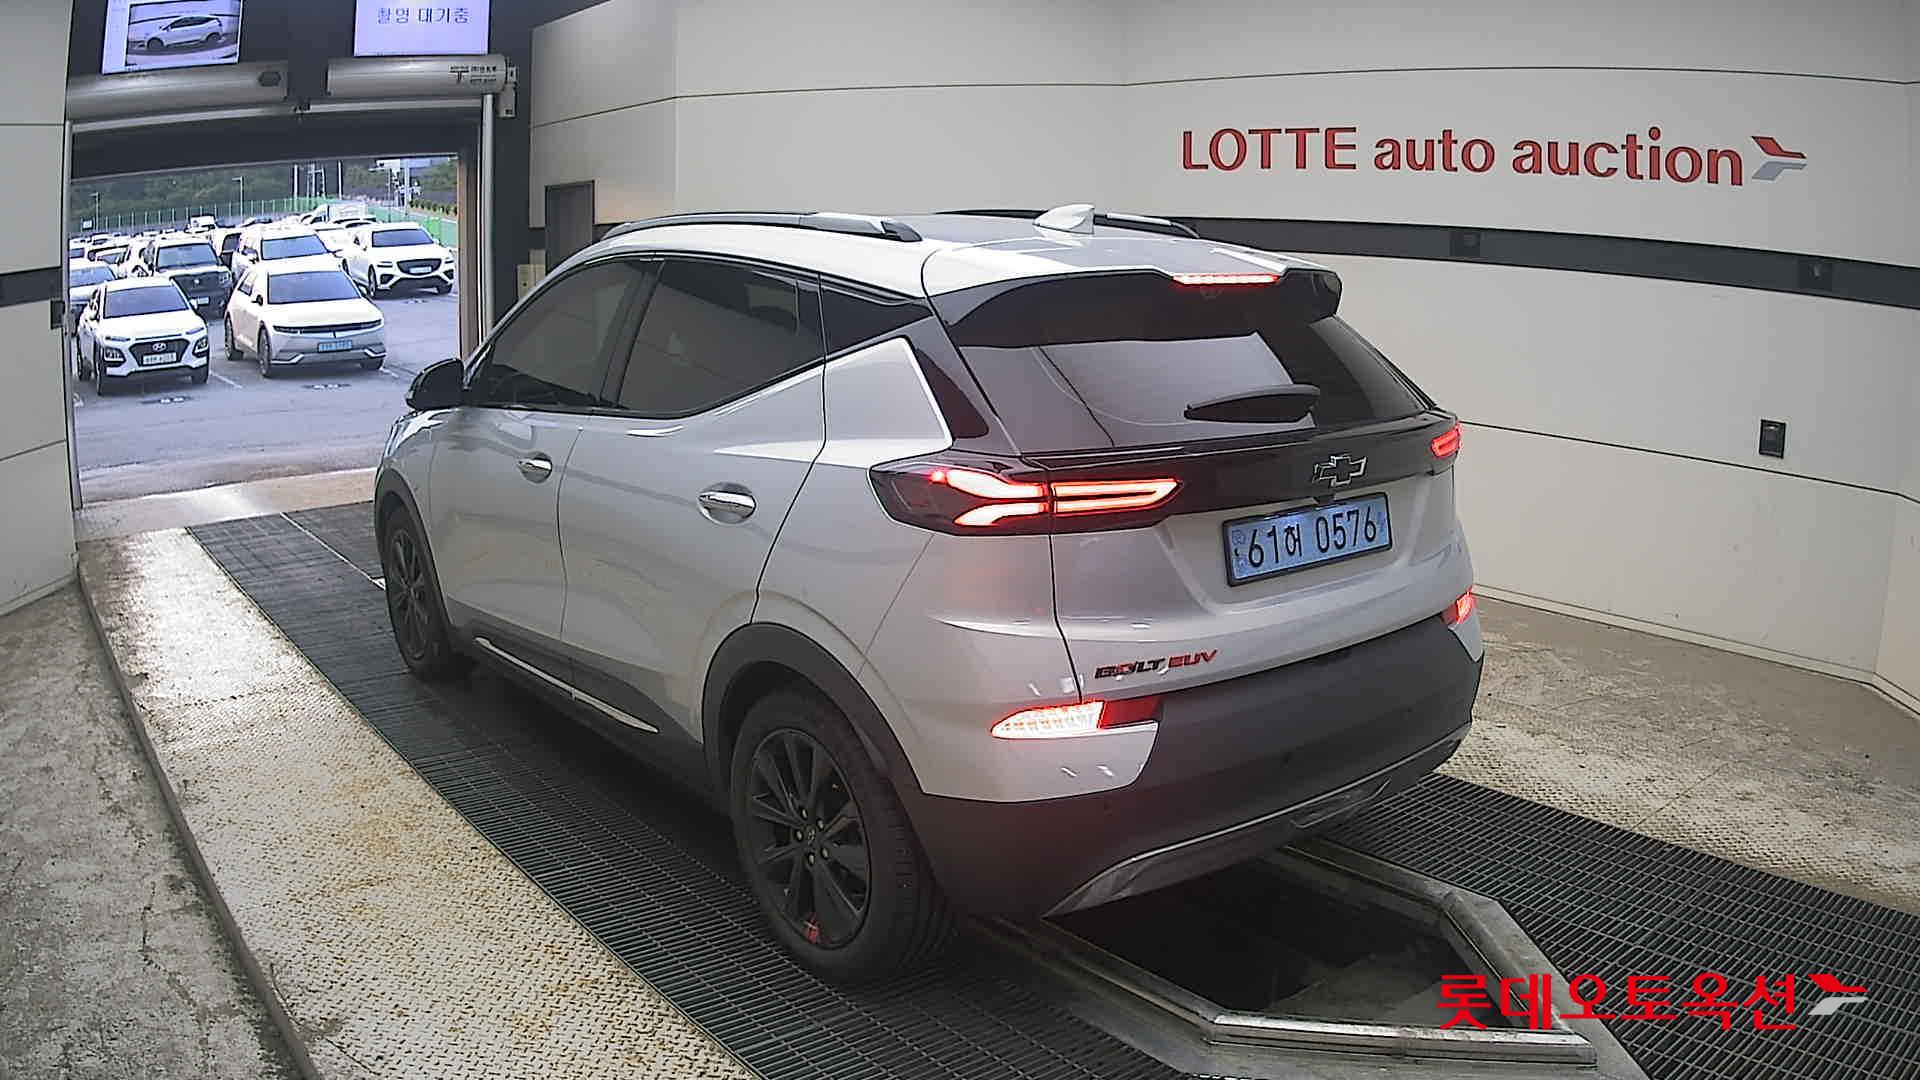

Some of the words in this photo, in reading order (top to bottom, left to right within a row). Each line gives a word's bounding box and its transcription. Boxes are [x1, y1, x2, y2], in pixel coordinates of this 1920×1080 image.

[418, 7, 469, 24] 대기중
[1183, 127, 1357, 172] LOTTE
[1374, 129, 1497, 173] auto
[1512, 126, 1744, 187] auction
[1248, 523, 1303, 568] 61허
[1315, 506, 1378, 554] 0576
[1094, 657, 1166, 679] BOLT
[1168, 649, 1218, 669] EUV
